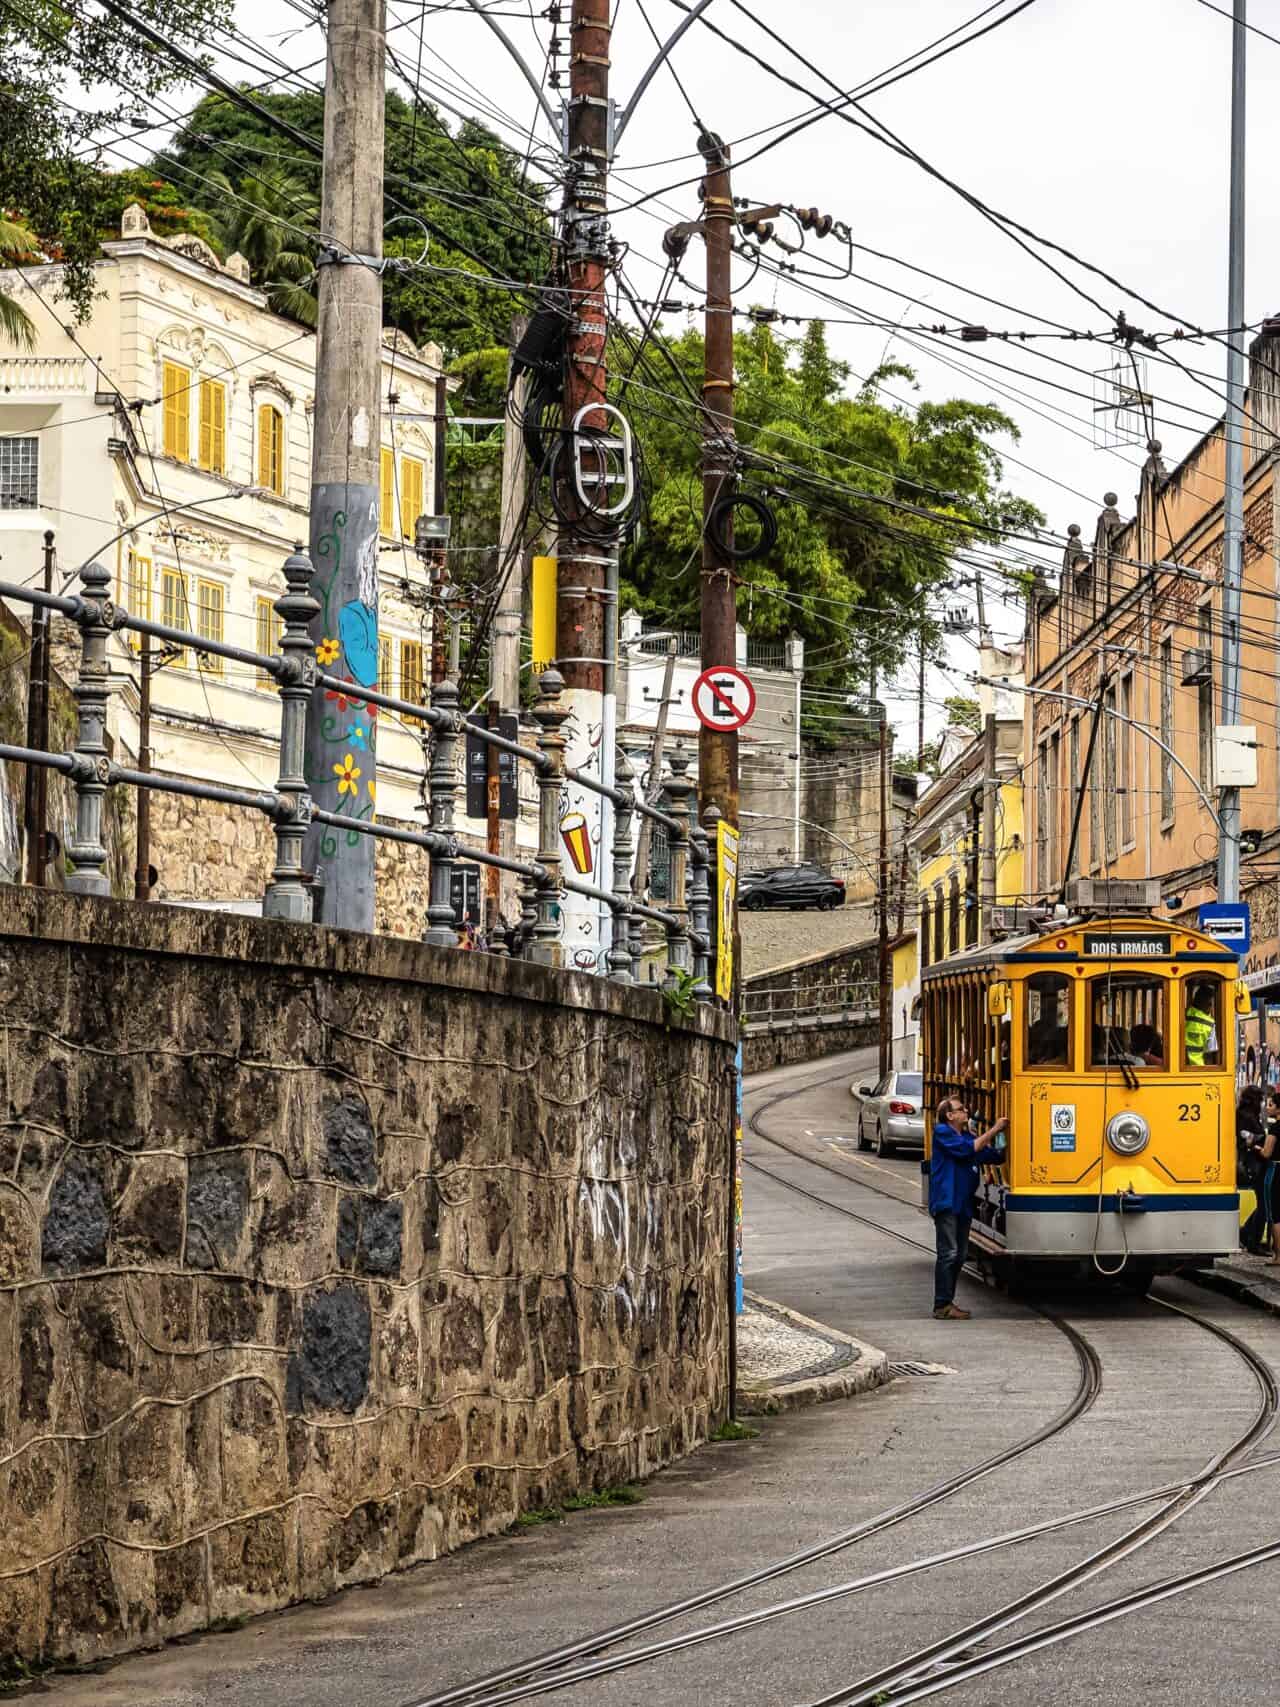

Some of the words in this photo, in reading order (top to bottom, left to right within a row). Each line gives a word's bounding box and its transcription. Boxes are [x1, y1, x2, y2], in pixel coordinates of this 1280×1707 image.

[1091, 943, 1119, 955] DOIS
[1121, 940, 1164, 955] IRMÃOS
[1177, 1104, 1201, 1121] 23
